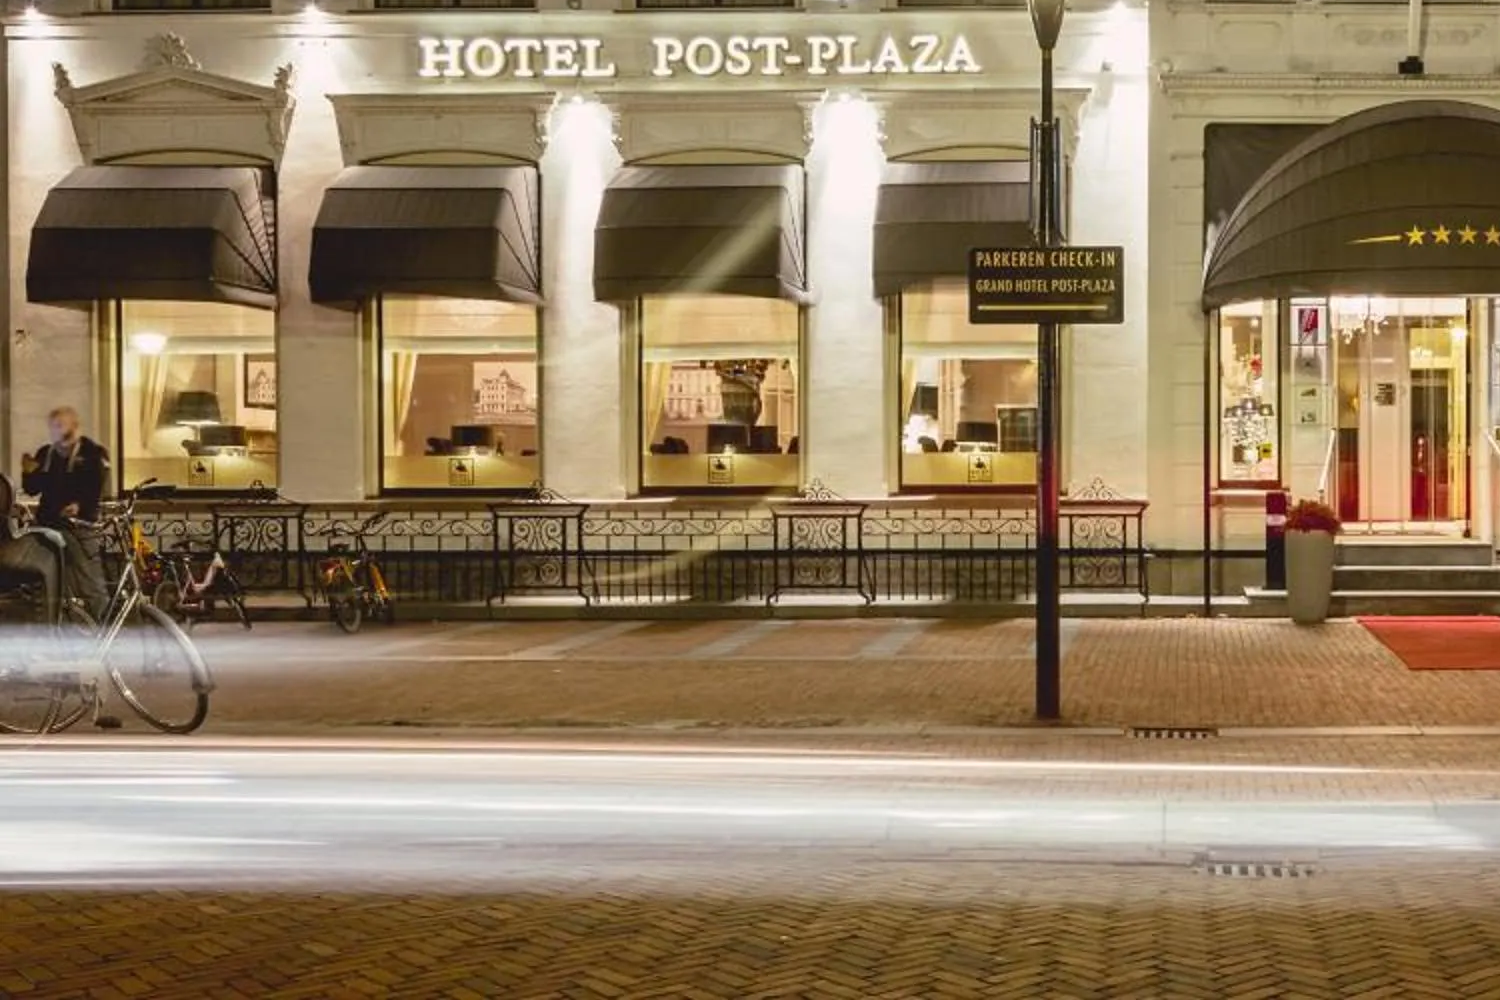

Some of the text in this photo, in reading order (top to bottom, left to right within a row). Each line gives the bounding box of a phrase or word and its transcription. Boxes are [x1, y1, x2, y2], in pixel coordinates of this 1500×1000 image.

[418, 34, 981, 78] HOTEL POST-PLAZA
[975, 251, 1115, 267] PARKEREN CHECK-IN
[975, 279, 1115, 293] GRAND HOTEL POST-PLAZA
